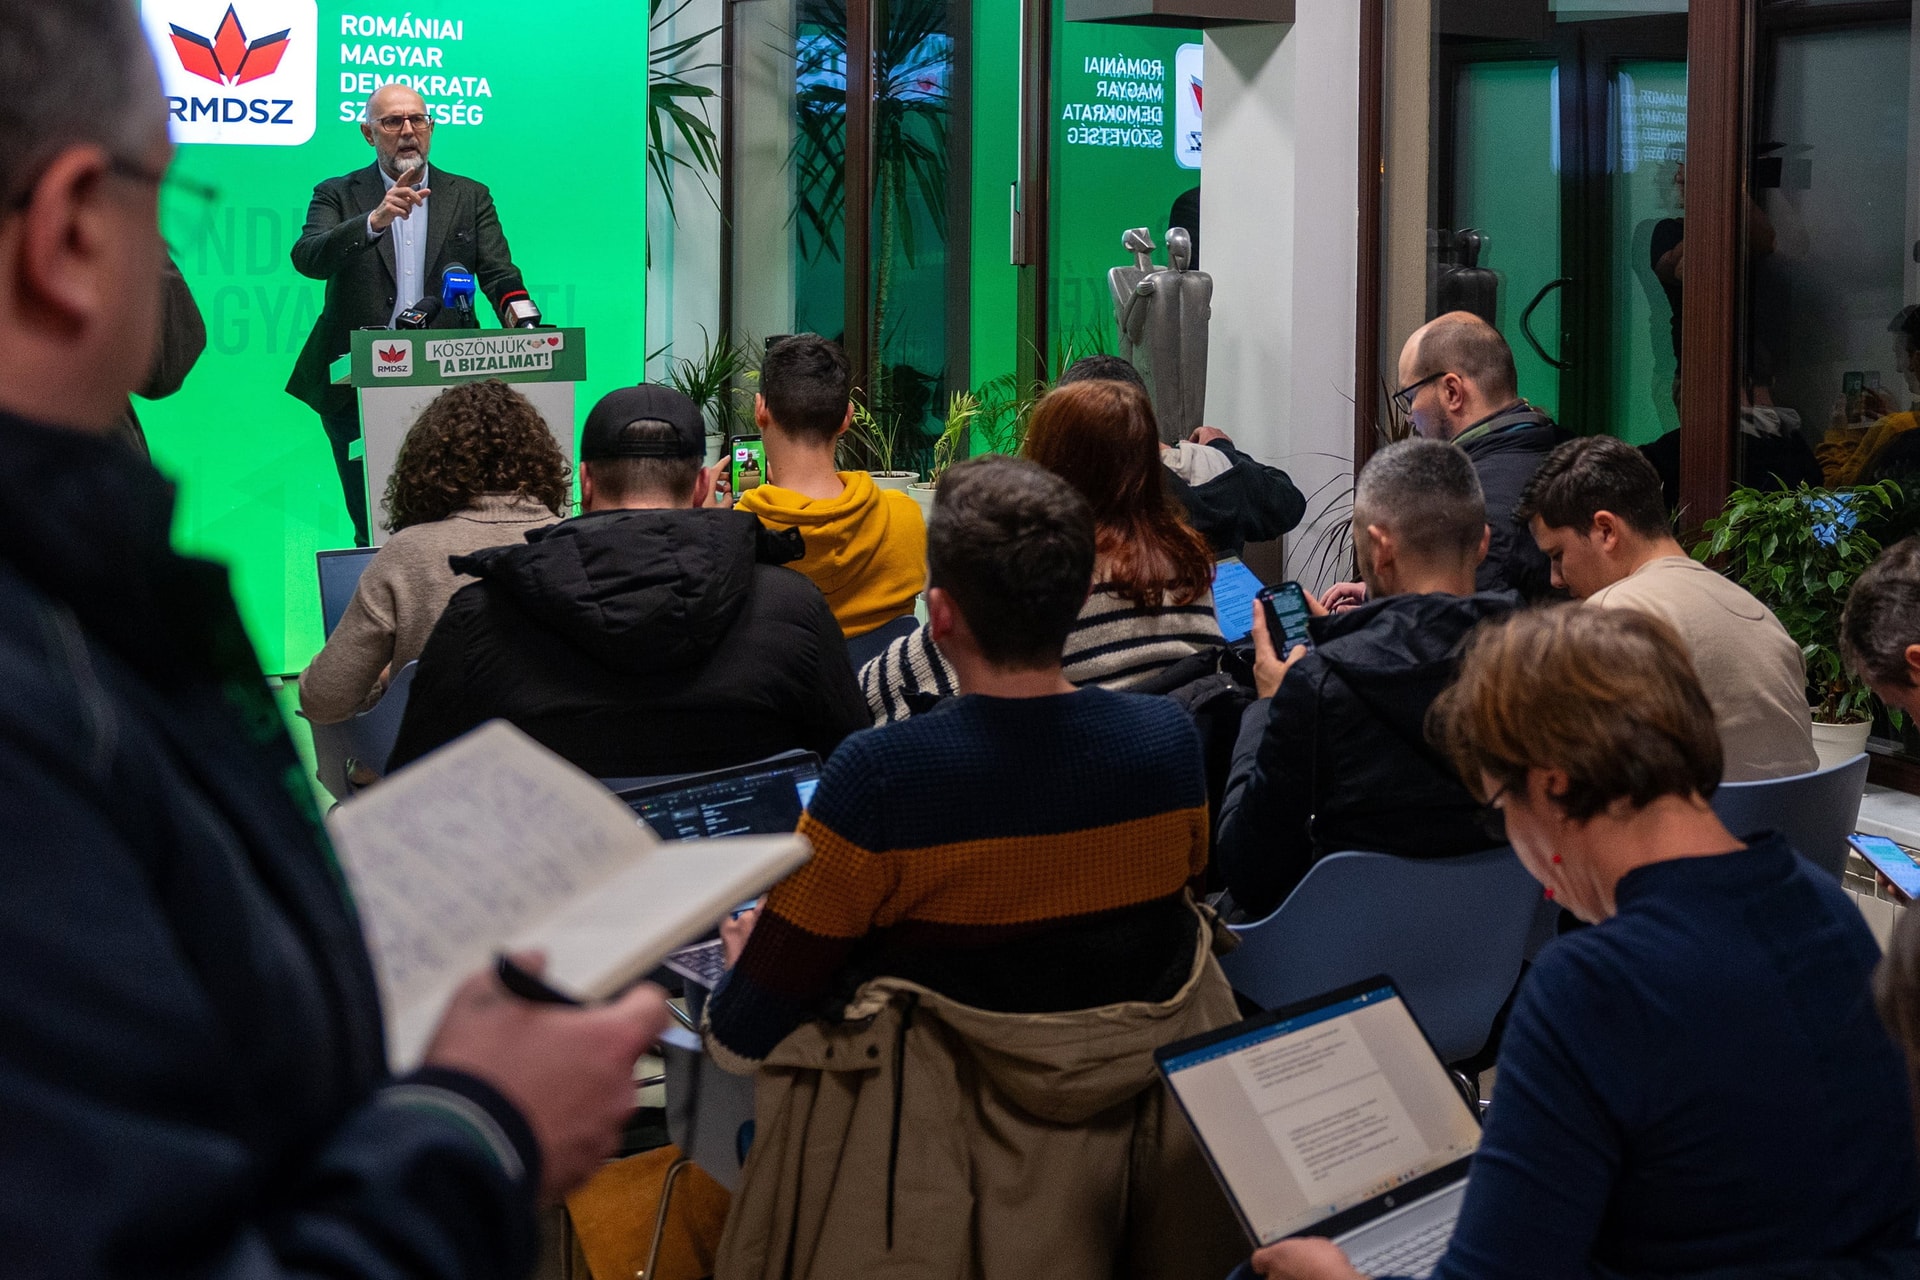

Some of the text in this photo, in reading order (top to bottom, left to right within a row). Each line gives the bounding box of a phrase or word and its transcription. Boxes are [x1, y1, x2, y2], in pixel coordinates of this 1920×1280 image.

[340, 12, 464, 41] ROMÁNIAI
[340, 43, 443, 68] MAGYAR
[166, 95, 293, 124] RMDSZ
[433, 336, 526, 358] KÖSZÖNJÜK
[377, 365, 408, 373] RMDSZ
[443, 353, 549, 374] A BIZALMAT!
